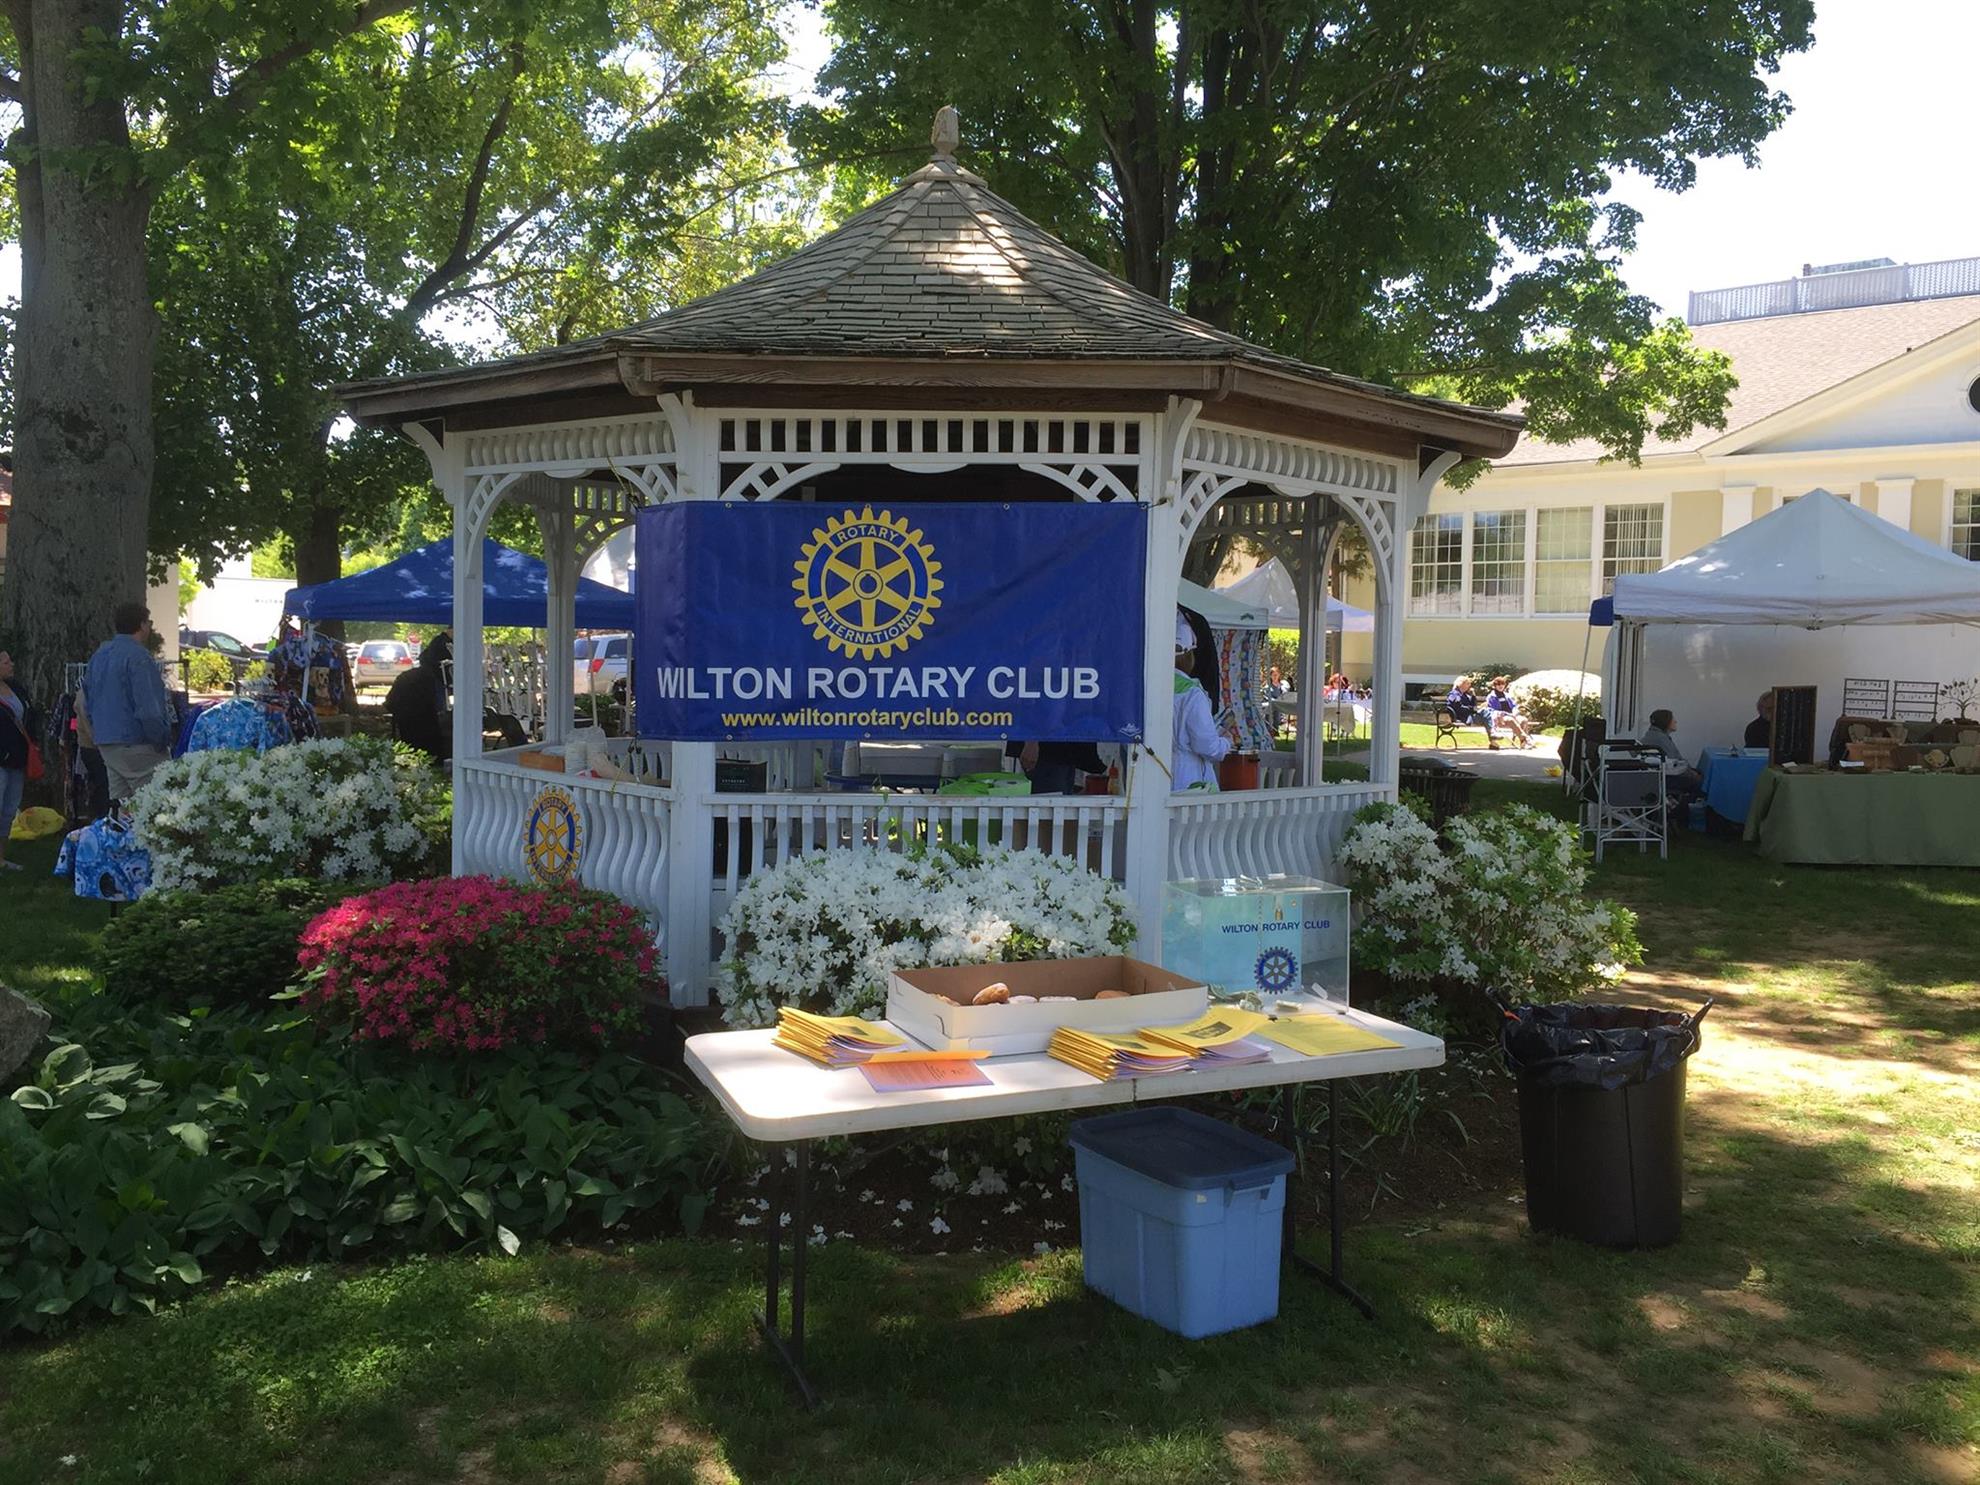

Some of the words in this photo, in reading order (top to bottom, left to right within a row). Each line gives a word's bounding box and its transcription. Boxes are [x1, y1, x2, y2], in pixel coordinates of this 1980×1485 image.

[837, 524, 900, 544] ROTARY
[817, 607, 922, 645] INTERNATIONAL
[657, 666, 793, 700] WILTON
[808, 666, 975, 699] ROTARY
[987, 666, 1100, 699] CLUB
[721, 708, 1013, 730] www.wiltonrotaryclub.com
[1222, 924, 1258, 934] WILTON
[1263, 922, 1300, 931] ROTARY
[1304, 920, 1330, 930] CLUB
